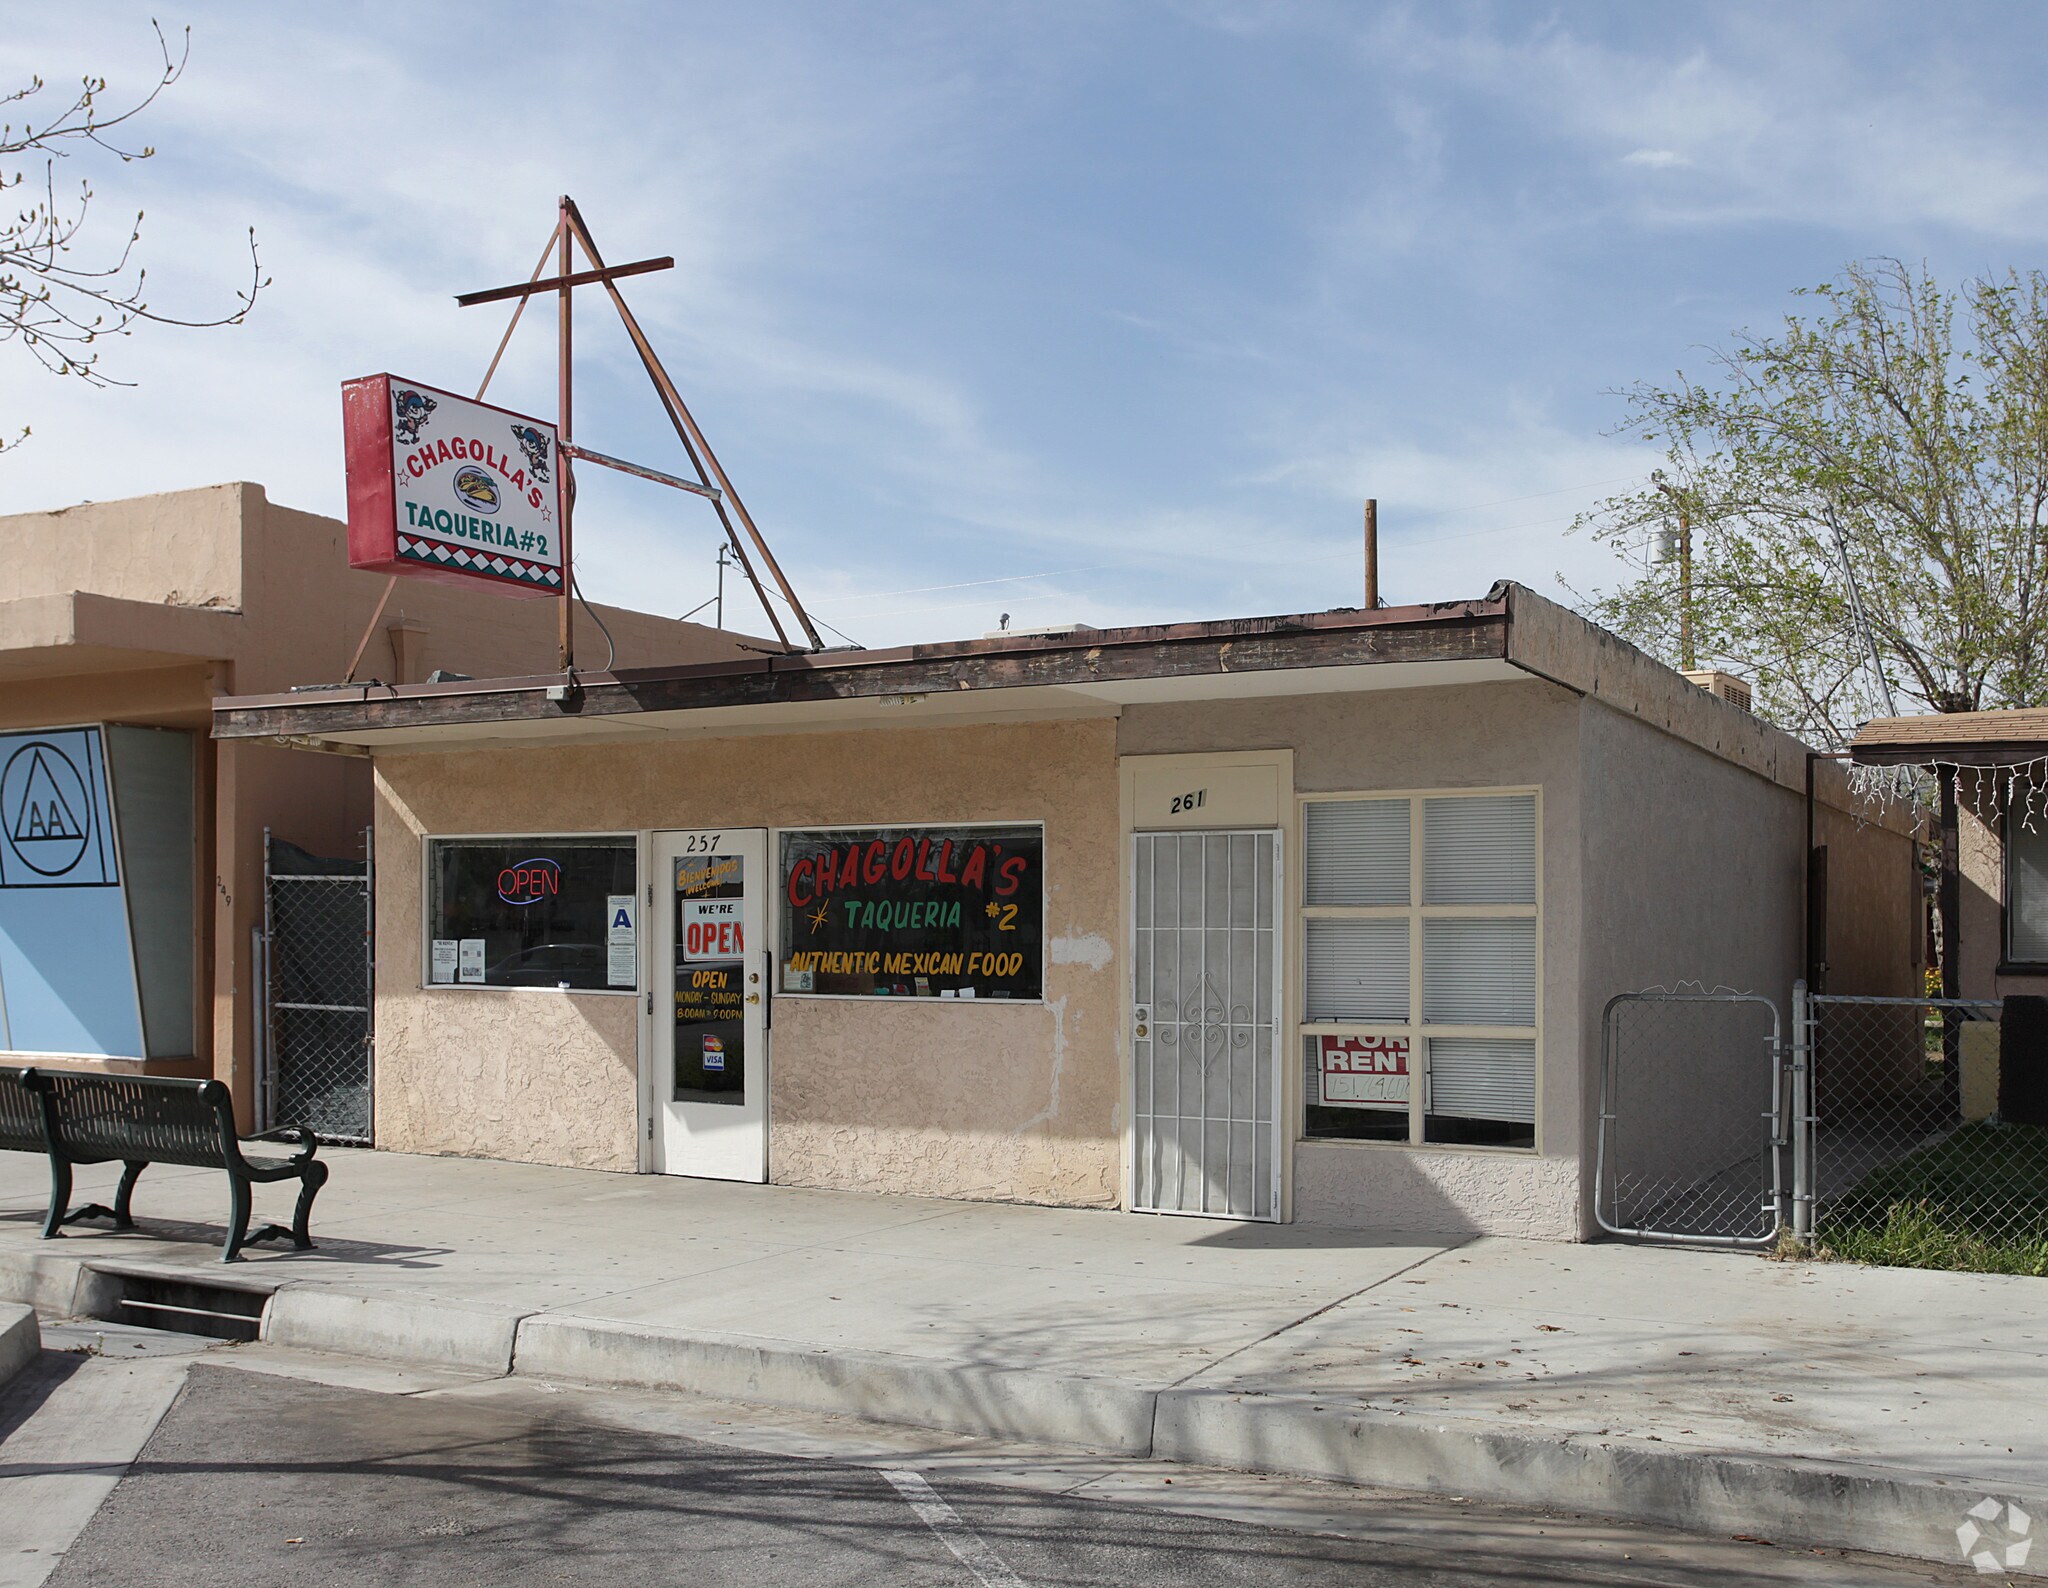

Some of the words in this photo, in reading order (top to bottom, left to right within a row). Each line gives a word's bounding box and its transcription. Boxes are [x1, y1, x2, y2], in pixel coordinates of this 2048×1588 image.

[406, 436, 544, 509] CHAGOLLA'S
[1170, 789, 1206, 815] 261
[29, 800, 65, 837] AA
[686, 834, 721, 853] 257
[497, 869, 559, 895] OPEN
[678, 859, 738, 887] BIENVENIDOS
[788, 836, 1027, 908] CHAGOLLA'S
[216, 875, 232, 907] 249
[612, 908, 632, 928] A
[698, 903, 734, 915] WE'RE
[844, 899, 961, 932] TAQUERIA
[985, 901, 1019, 931] #2
[687, 921, 744, 955] OPEN
[789, 950, 881, 975] AUTHENTIC
[883, 951, 964, 976] MEXICAN
[967, 951, 1023, 977] FOOD
[692, 970, 728, 989] OPEN
[675, 991, 704, 1004] MONDAY
[710, 992, 742, 1005] SUNDAY
[706, 1055, 723, 1064] VISA
